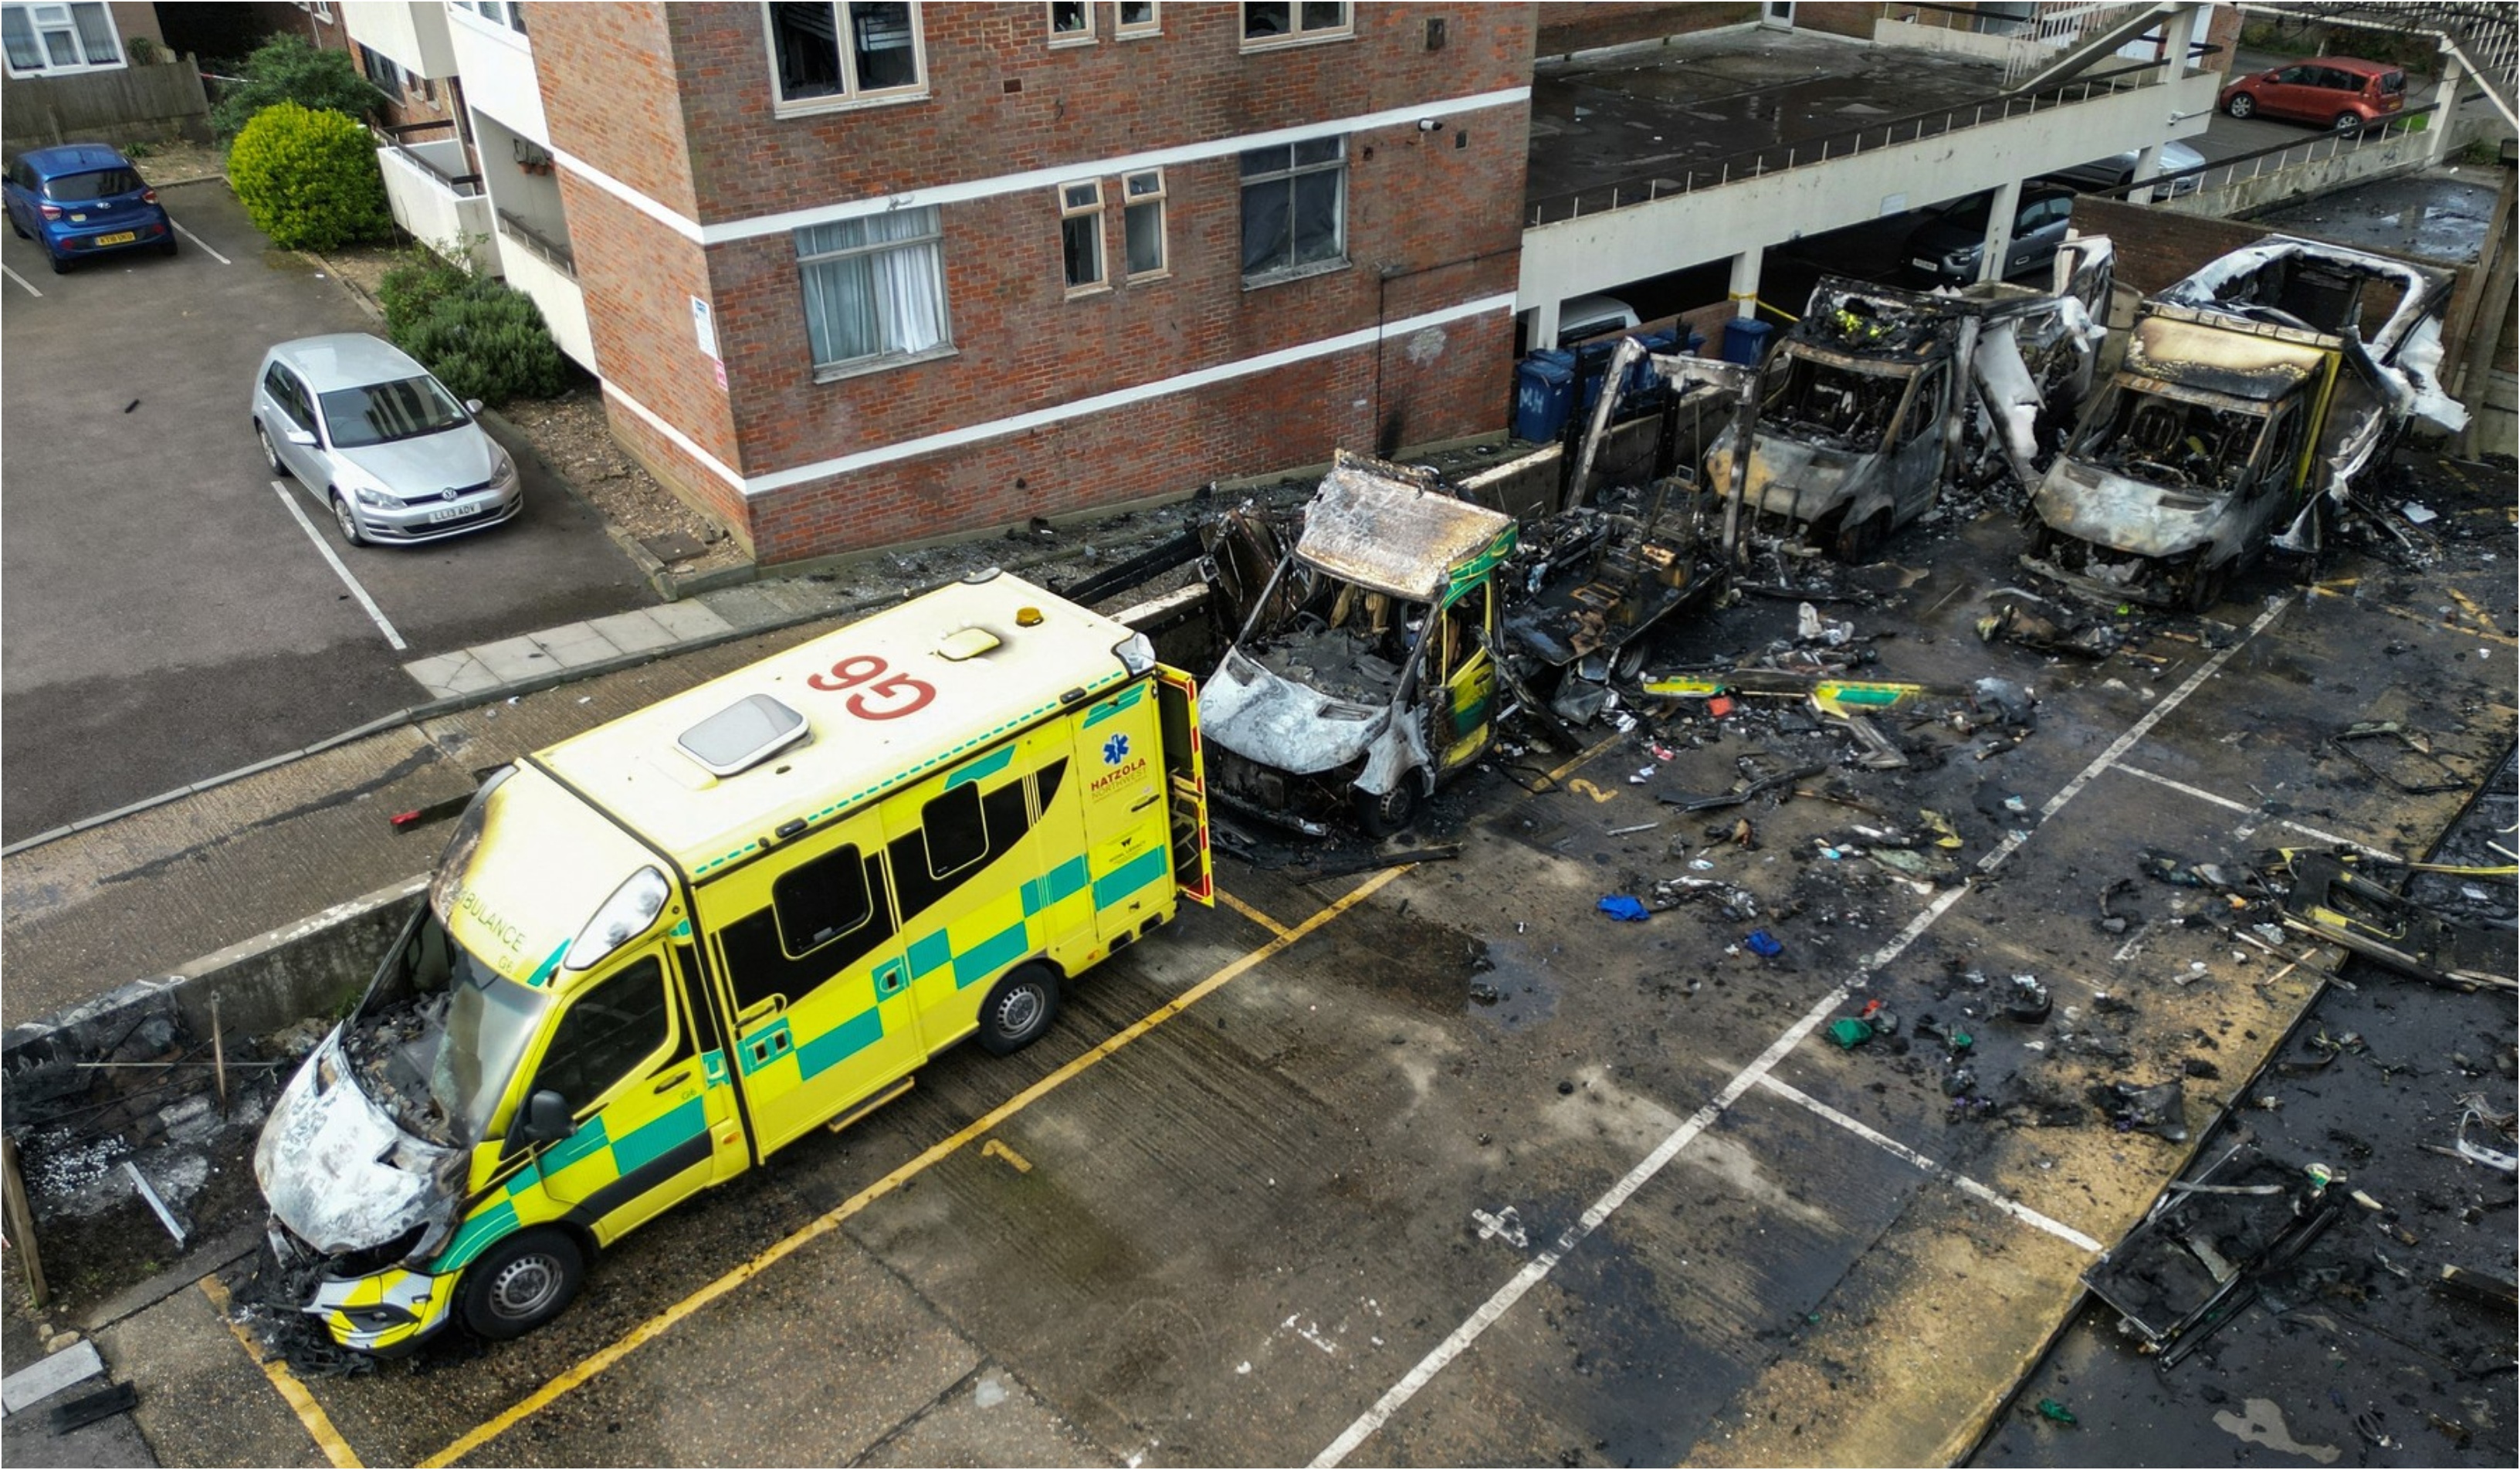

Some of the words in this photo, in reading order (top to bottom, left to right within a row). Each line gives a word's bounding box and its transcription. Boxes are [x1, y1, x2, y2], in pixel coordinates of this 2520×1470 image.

[435, 509, 457, 520] LL13
[807, 655, 937, 721] G6
[1091, 757, 1147, 792] HATZOLA
[1092, 767, 1147, 800] NORTHWEST
[1569, 778, 1618, 803] 2
[498, 955, 514, 974] G6
[982, 1138, 1033, 1173] 1
